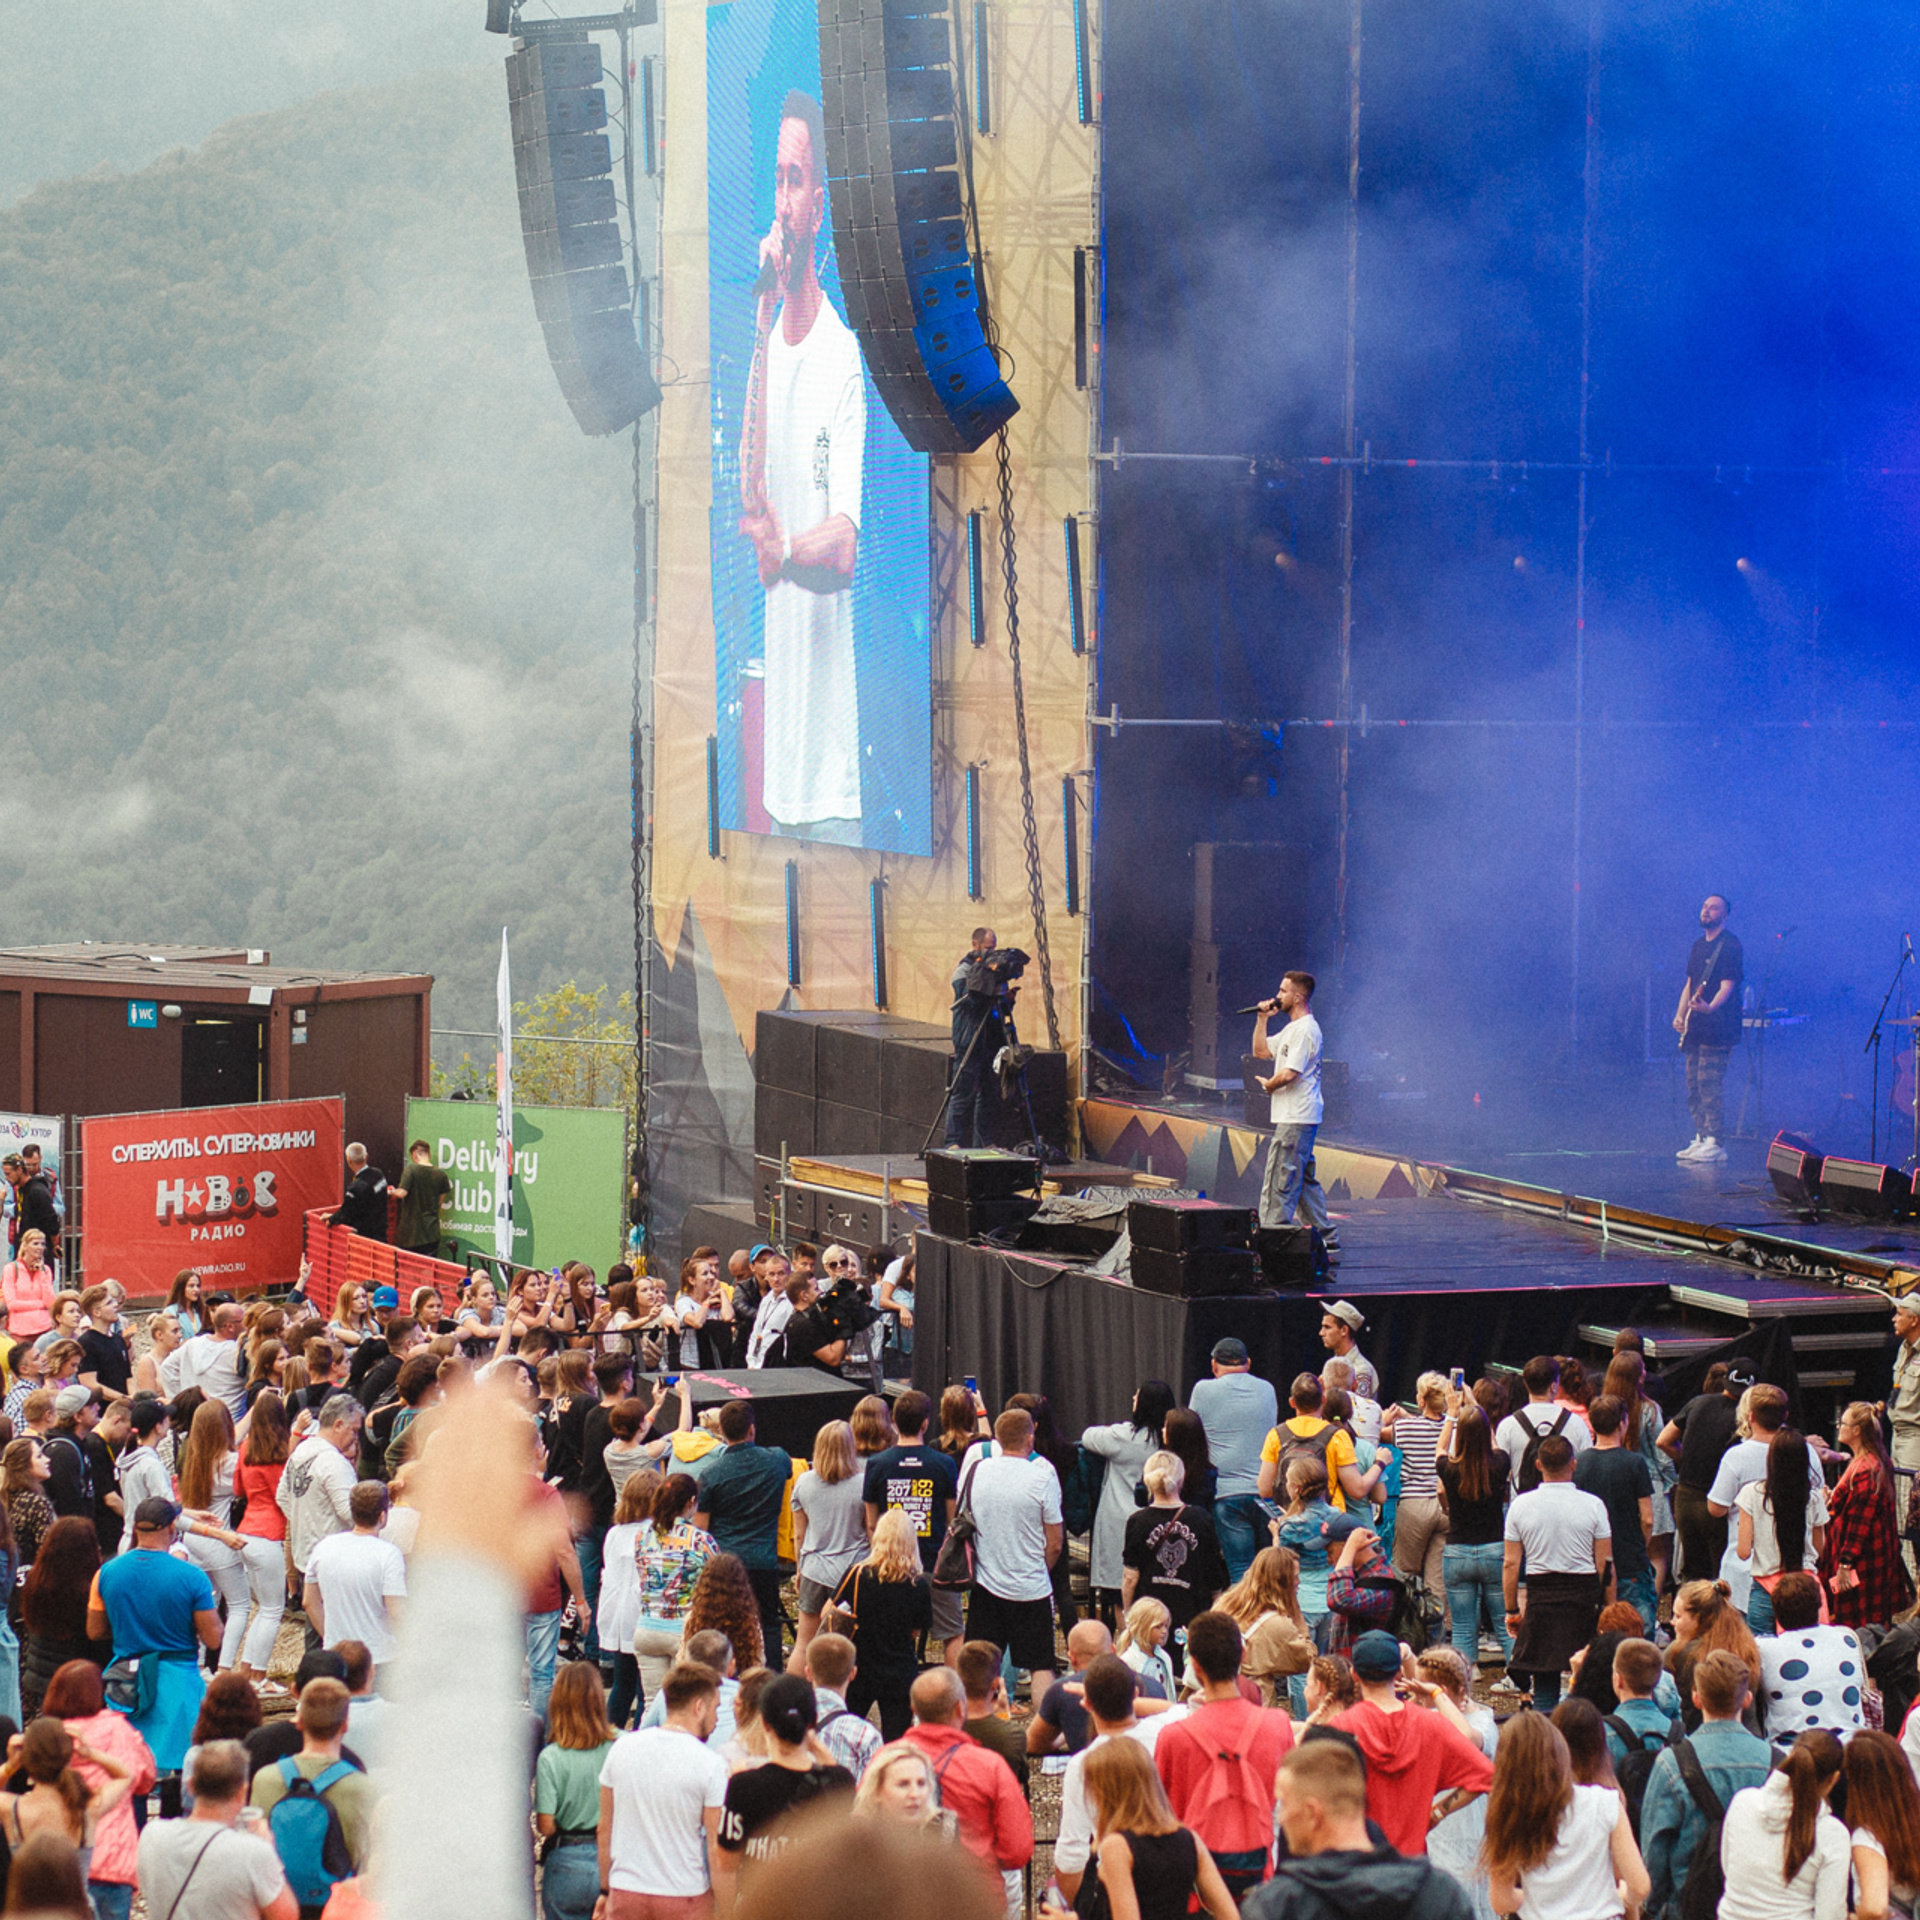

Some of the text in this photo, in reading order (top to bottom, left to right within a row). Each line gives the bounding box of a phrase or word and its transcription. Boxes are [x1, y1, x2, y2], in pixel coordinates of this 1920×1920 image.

[138, 1008, 154, 1020] WC
[31, 1128, 52, 1138] ХУТОР
[438, 1138, 538, 1184] Delivry
[190, 1223, 246, 1241] РАДИО
[886, 1485, 911, 1497] 207
